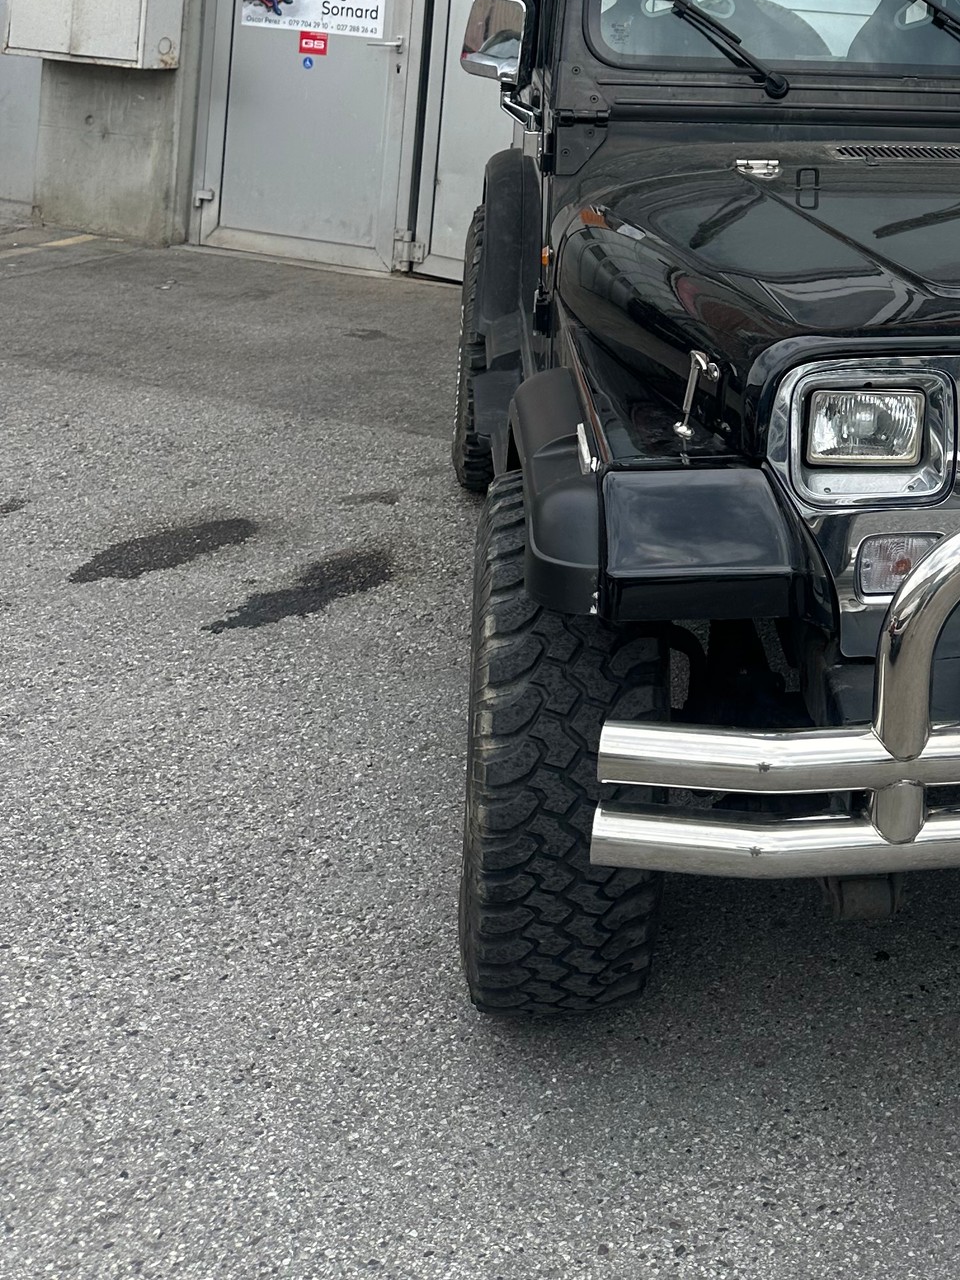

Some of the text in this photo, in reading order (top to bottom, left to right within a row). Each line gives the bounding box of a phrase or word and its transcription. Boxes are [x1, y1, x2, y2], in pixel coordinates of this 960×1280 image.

[321, 1, 379, 20] Sornard
[300, 20, 312, 28] 704
[336, 23, 348, 31] 027
